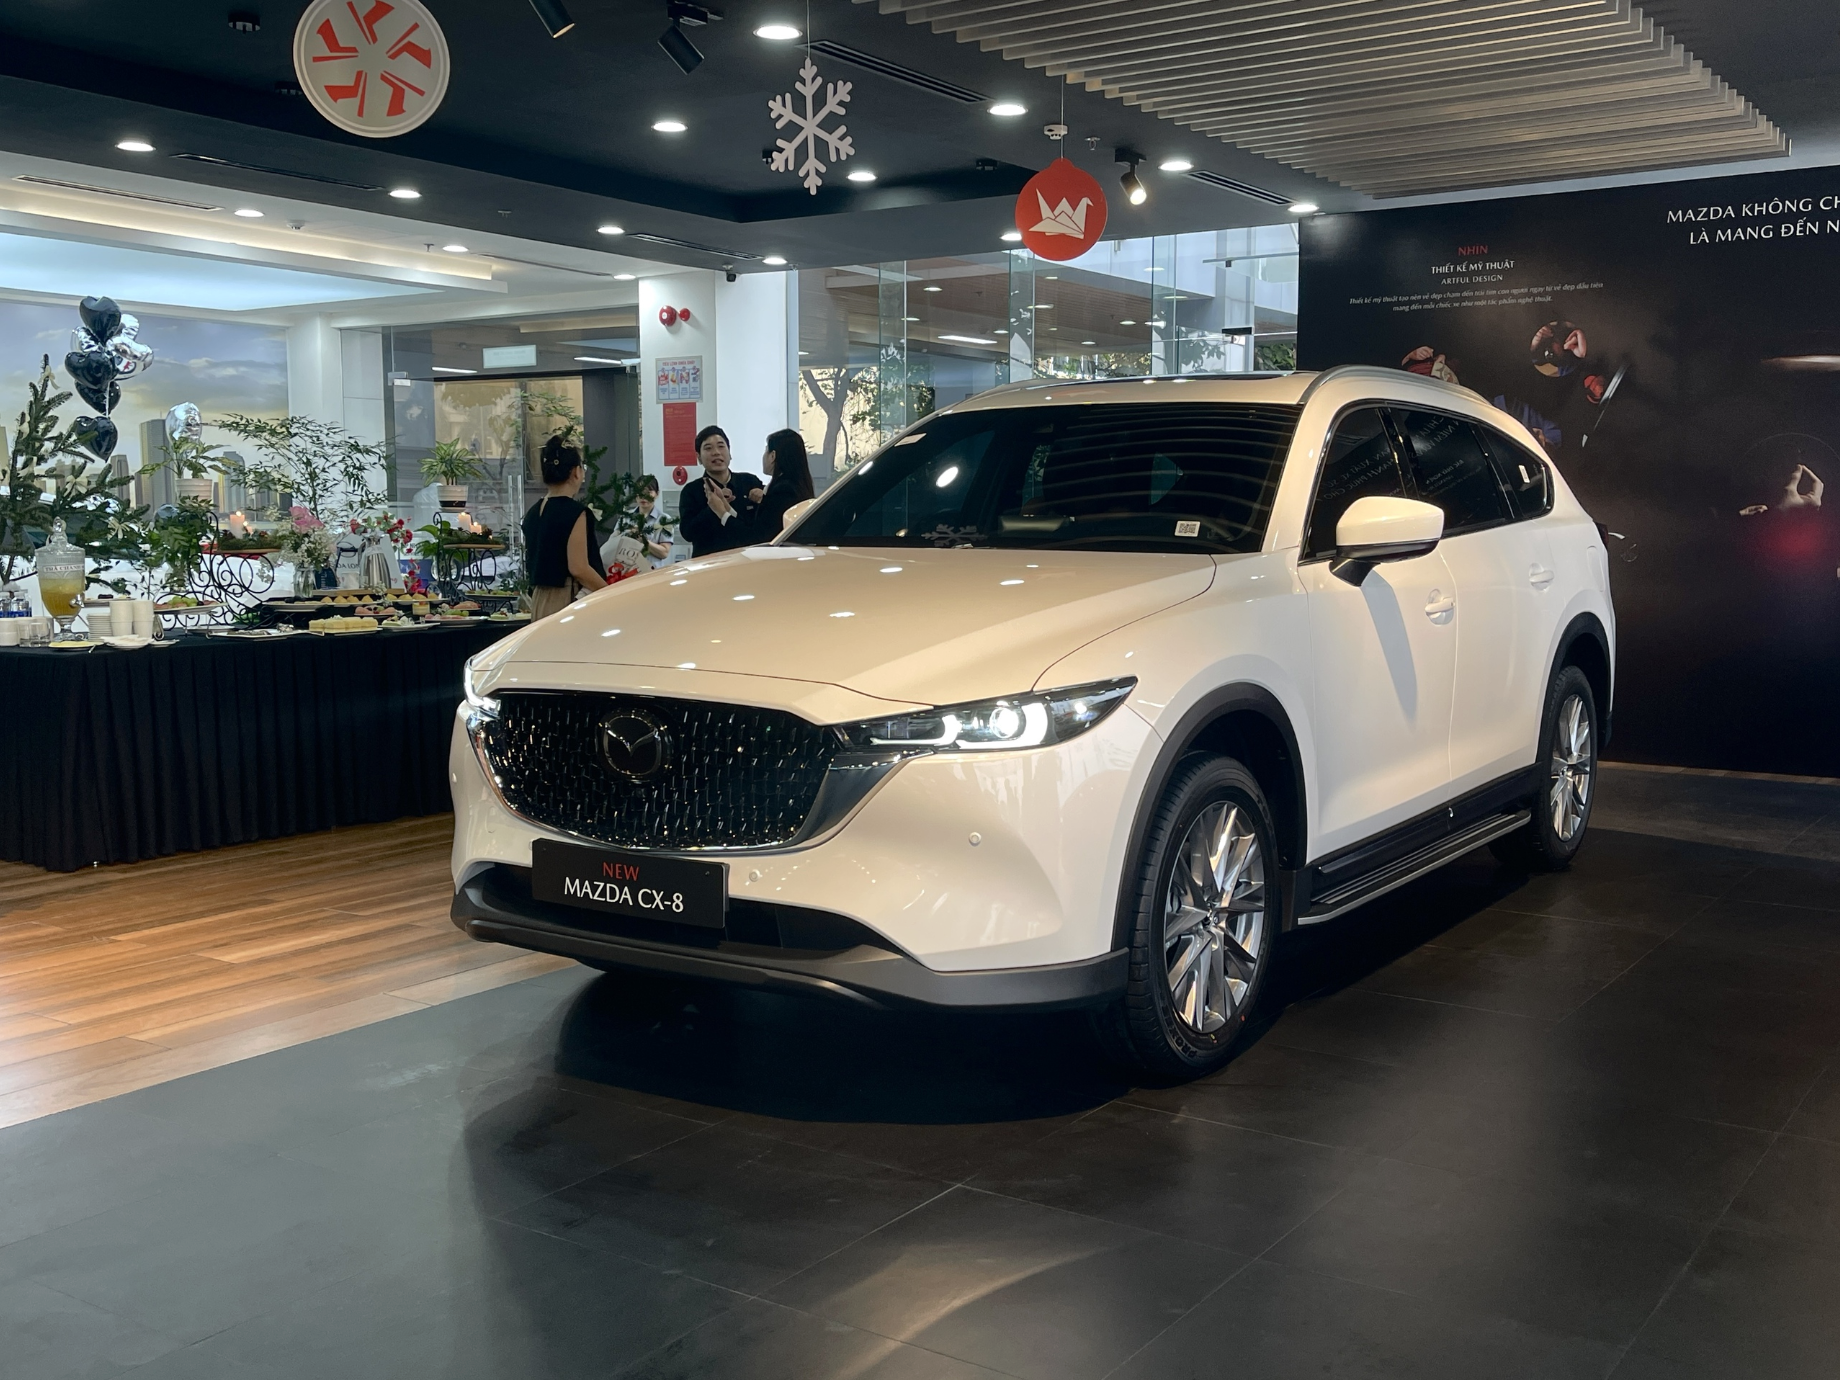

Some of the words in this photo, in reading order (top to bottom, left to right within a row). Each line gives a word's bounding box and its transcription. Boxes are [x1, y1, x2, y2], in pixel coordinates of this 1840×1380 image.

[1666, 206, 1735, 223] MAZDA
[1742, 197, 1812, 216] KHÔNG
[1690, 228, 1710, 244] LÀ
[1716, 225, 1773, 242] MANG
[1780, 217, 1819, 237] ĐẾN
[1826, 220, 1840, 234] N
[1431, 262, 1454, 274] THIẾT
[1456, 261, 1468, 272] KẾ
[1469, 260, 1483, 271] MỸ
[1486, 259, 1515, 270] THUẬT
[1441, 276, 1470, 285] ARTFUL
[1472, 274, 1503, 282] DESIGN
[603, 862, 639, 882] NEW
[564, 876, 633, 906] MAZDA
[638, 888, 684, 912] CX-8
